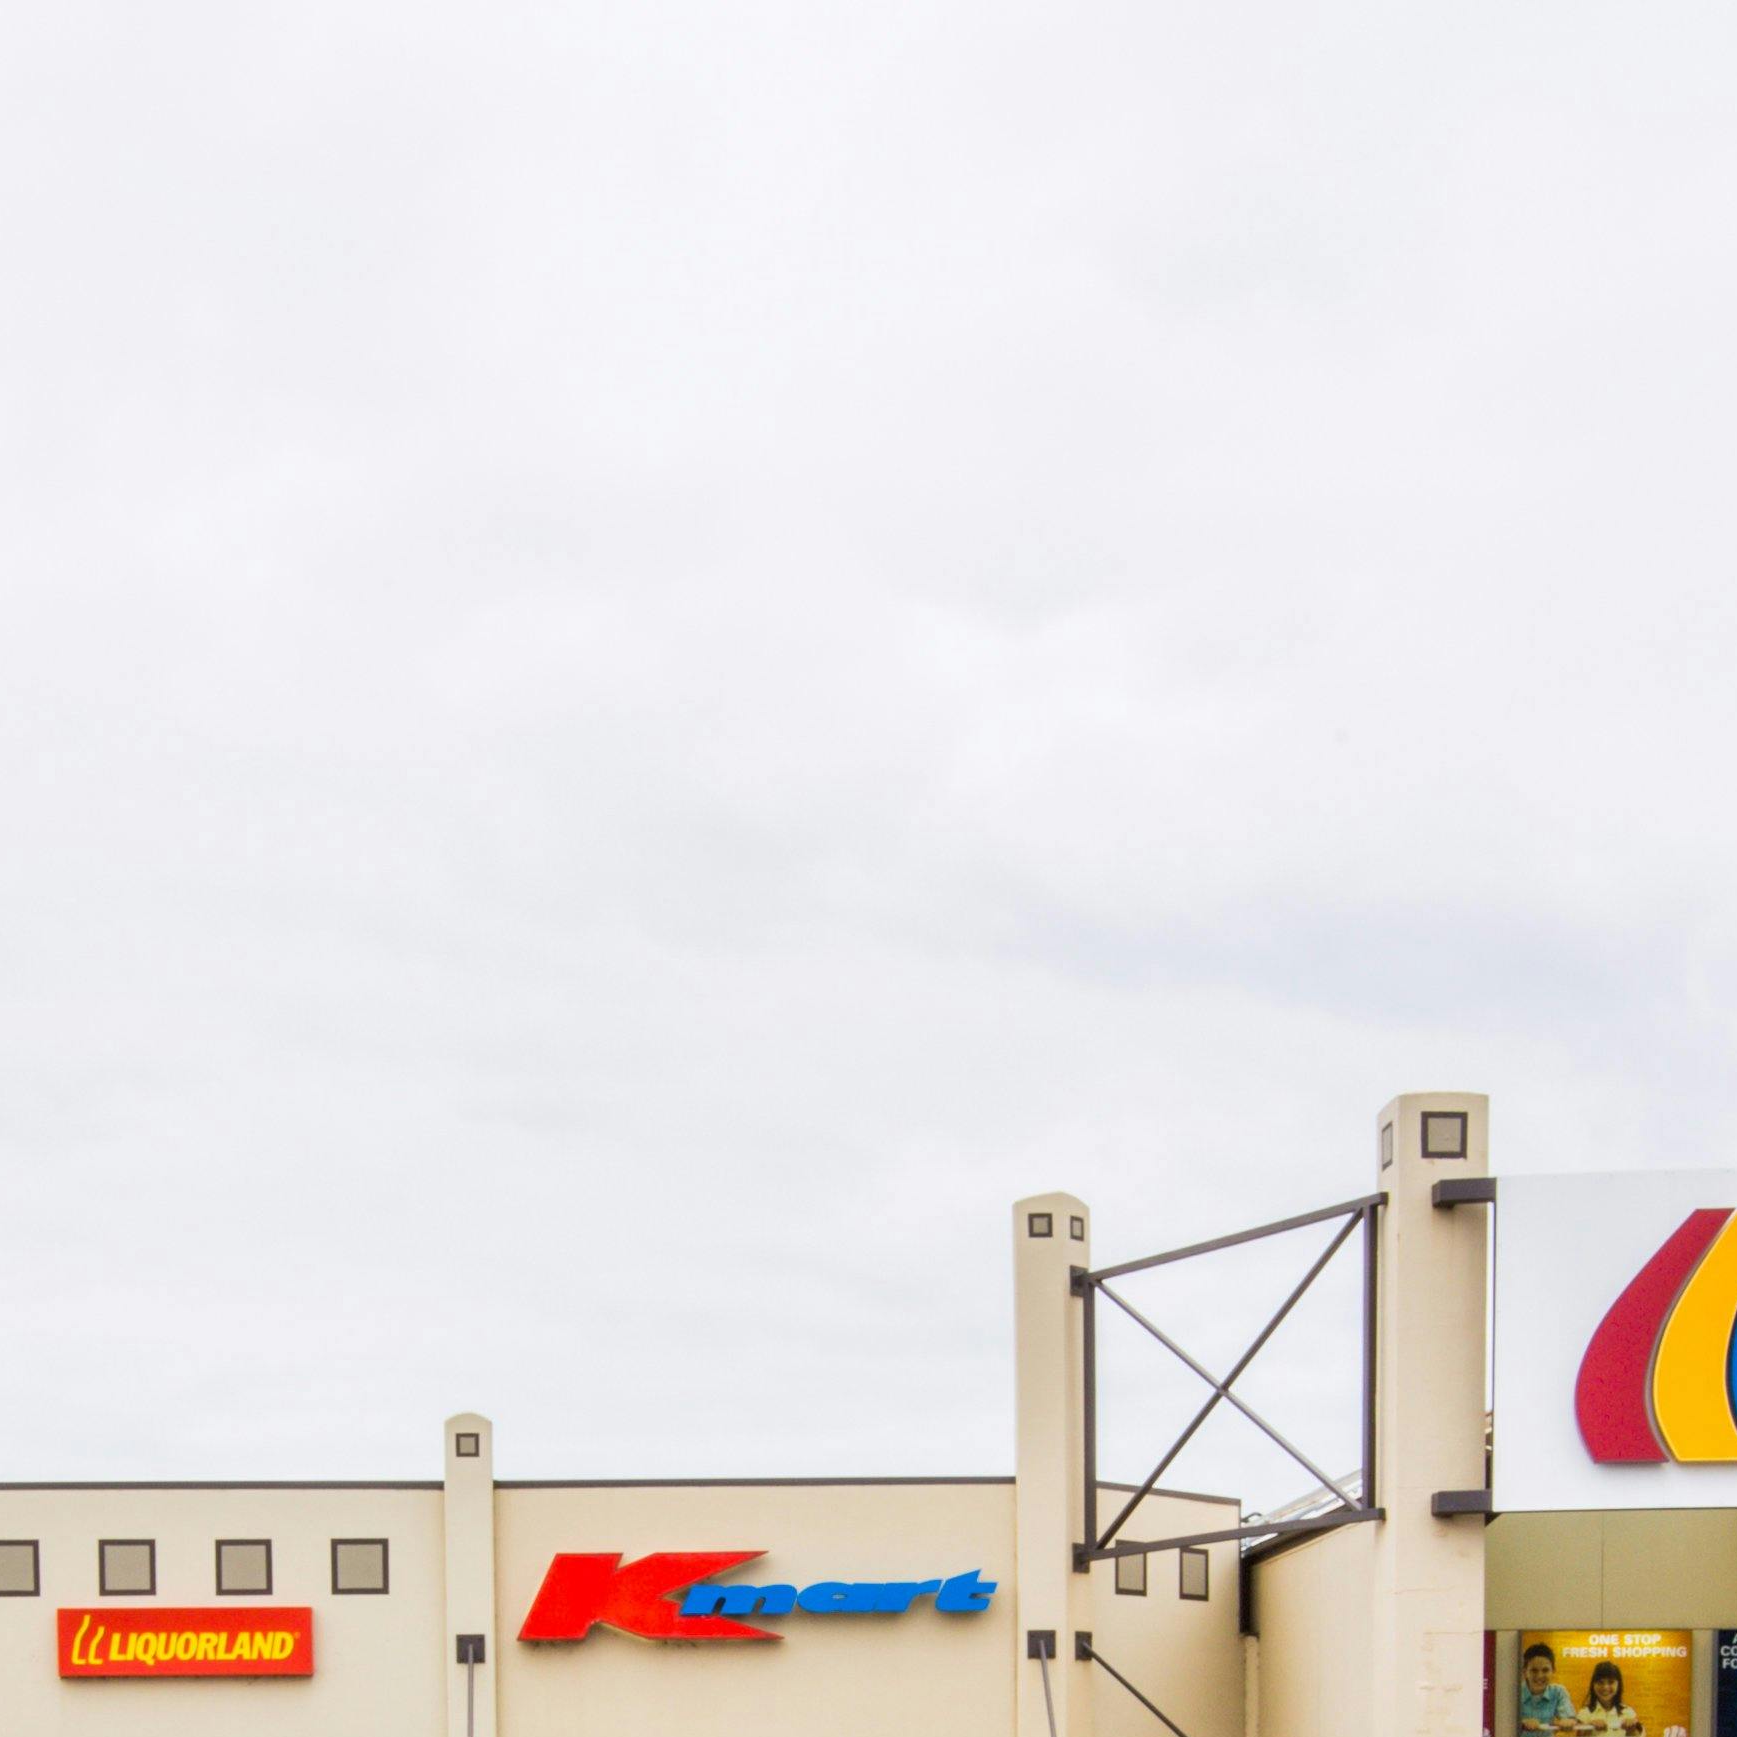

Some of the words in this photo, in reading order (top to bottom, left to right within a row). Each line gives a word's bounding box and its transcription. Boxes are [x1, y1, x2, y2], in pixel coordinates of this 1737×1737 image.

[517, 1551, 998, 1640] Kmart
[109, 1631, 294, 1665] LIQUORLAND
[1588, 1634, 1620, 1645] ONE
[1624, 1634, 1661, 1645] STOP
[1563, 1646, 1608, 1658] FRESH
[1613, 1646, 1687, 1658] SHOPPING
